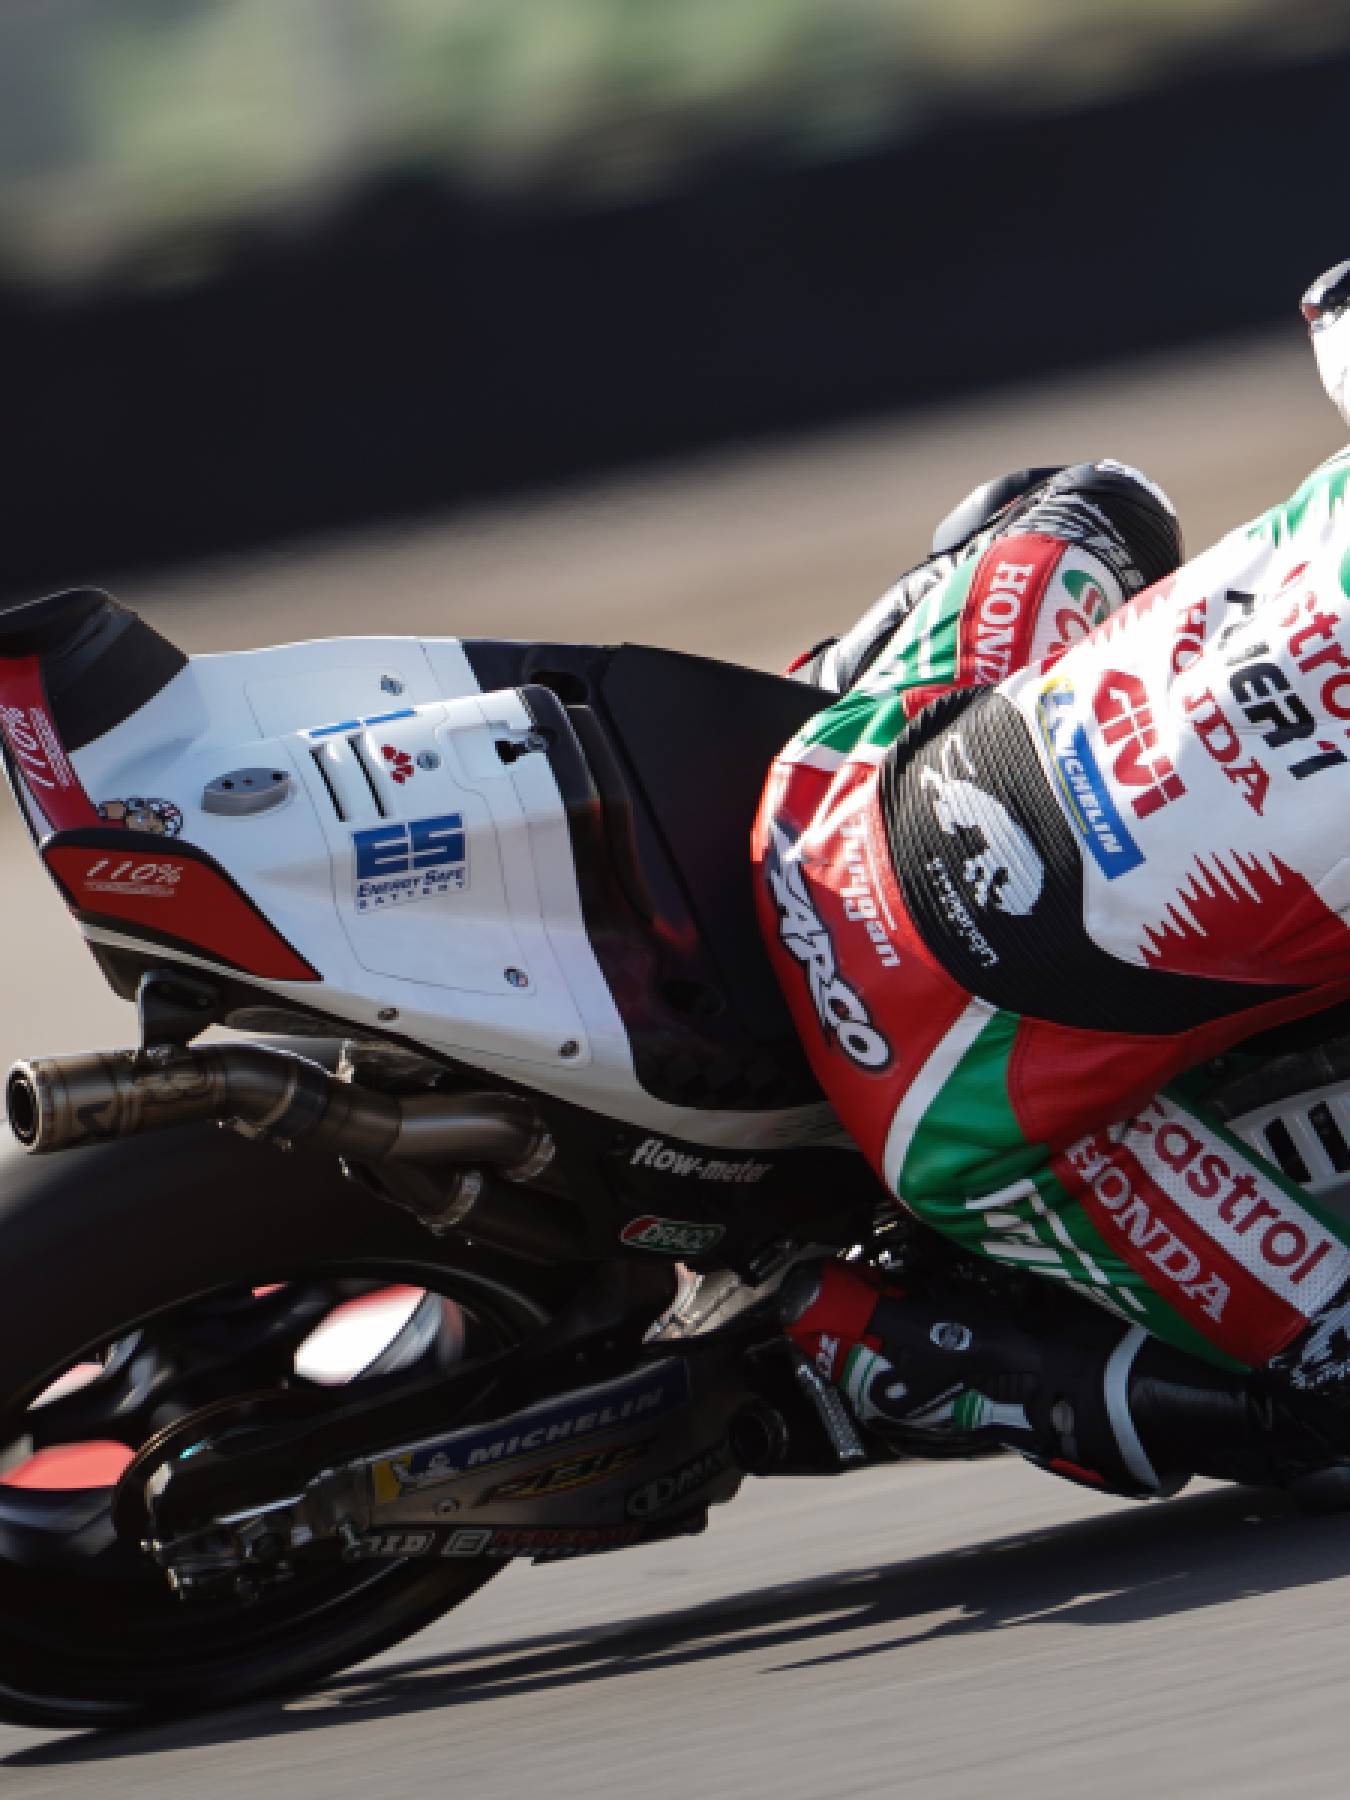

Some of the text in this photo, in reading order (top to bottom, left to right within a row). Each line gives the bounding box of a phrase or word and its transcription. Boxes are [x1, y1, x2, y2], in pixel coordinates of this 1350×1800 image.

[1093, 669, 1187, 820] GIVI
[86, 858, 183, 883] 110%
[354, 813, 465, 879] ES
[1064, 1136, 1231, 1324] HONDA
[466, 1385, 664, 1465] MICHELIN
